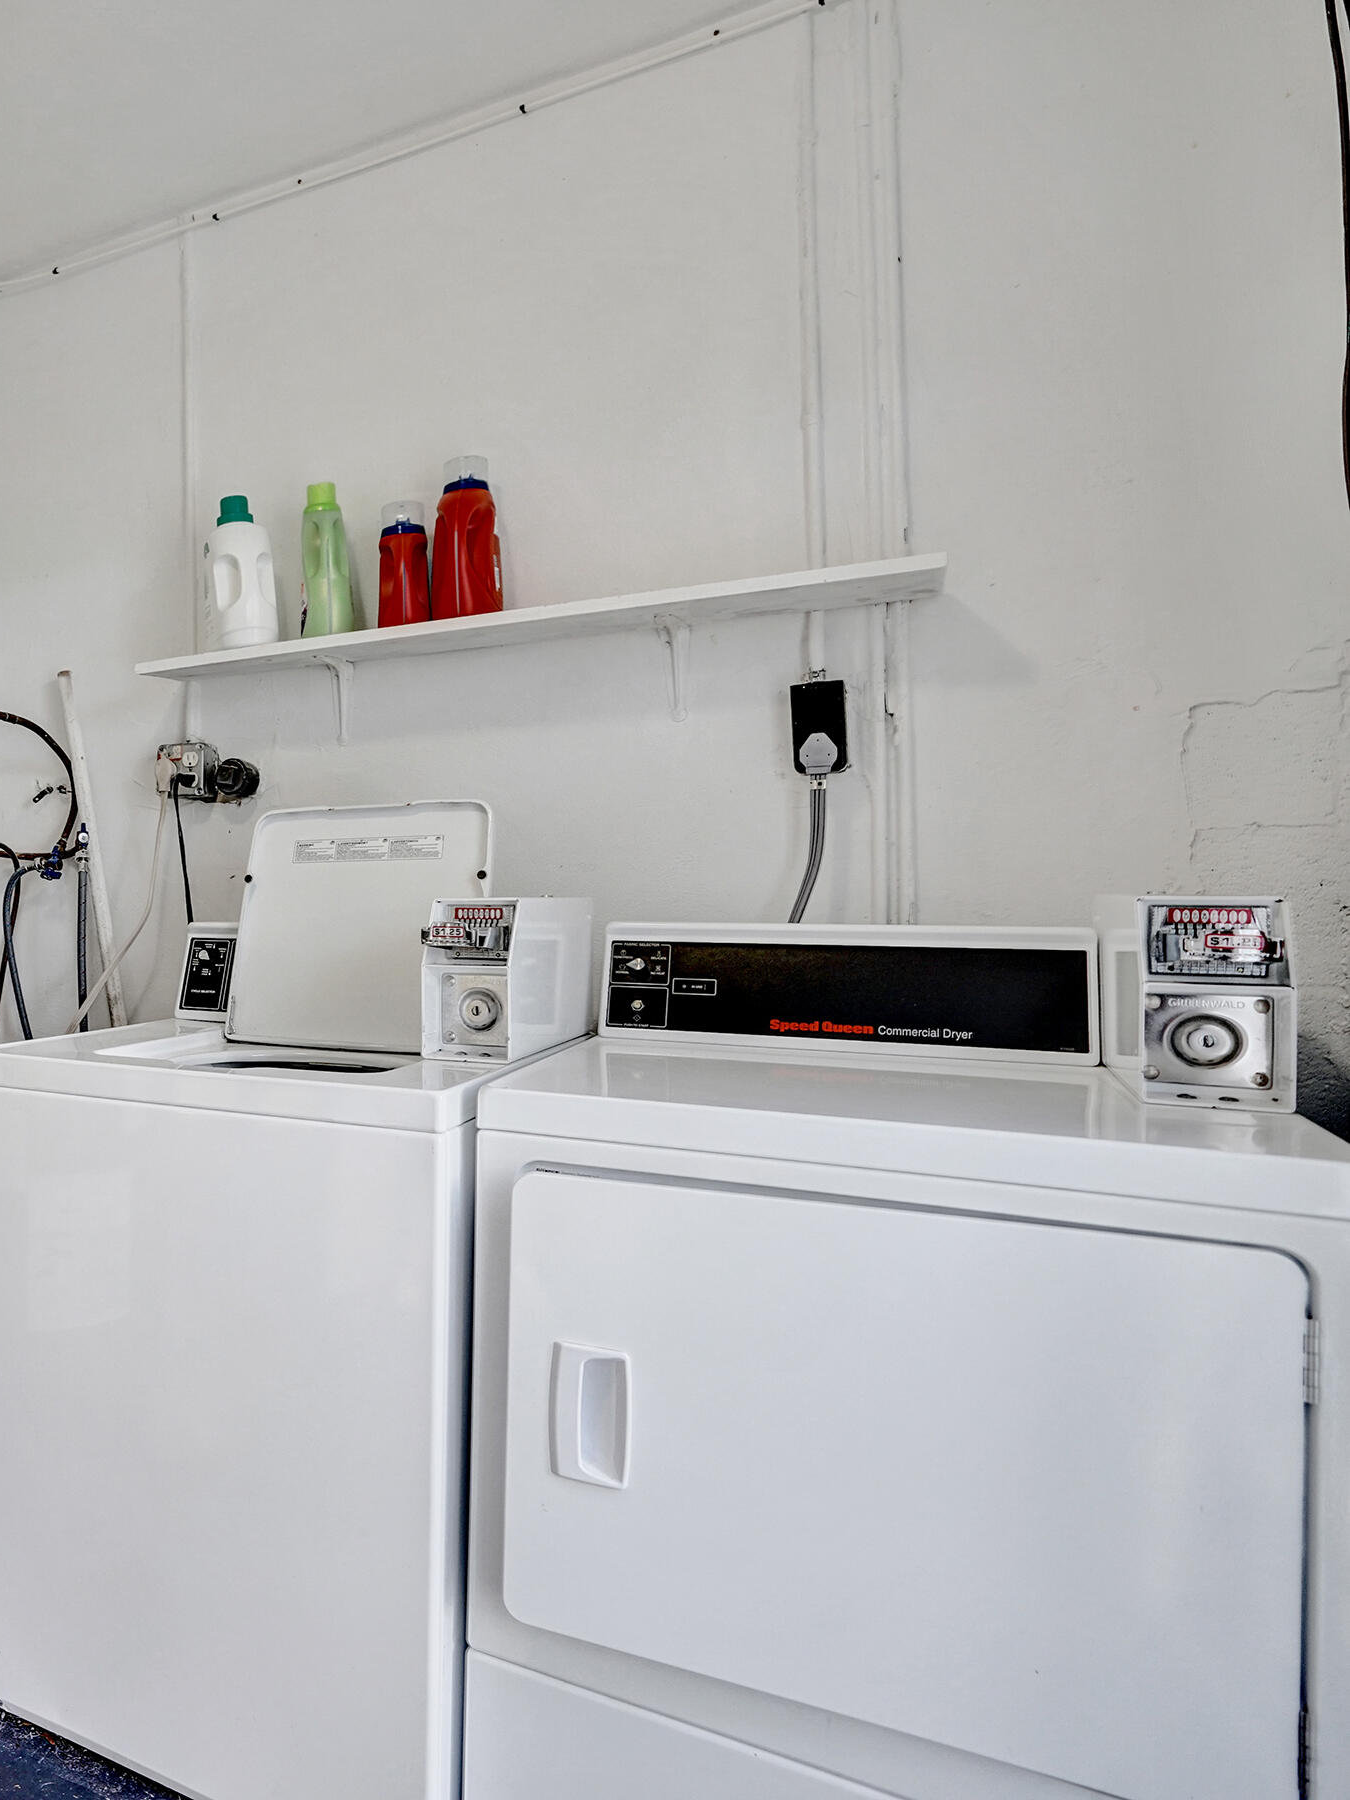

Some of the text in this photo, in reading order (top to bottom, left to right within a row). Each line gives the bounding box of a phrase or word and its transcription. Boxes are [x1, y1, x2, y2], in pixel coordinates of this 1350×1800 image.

[434, 928, 462, 936] $1.25
[769, 1018, 973, 1041] Speed Queen Commercial Dryer
